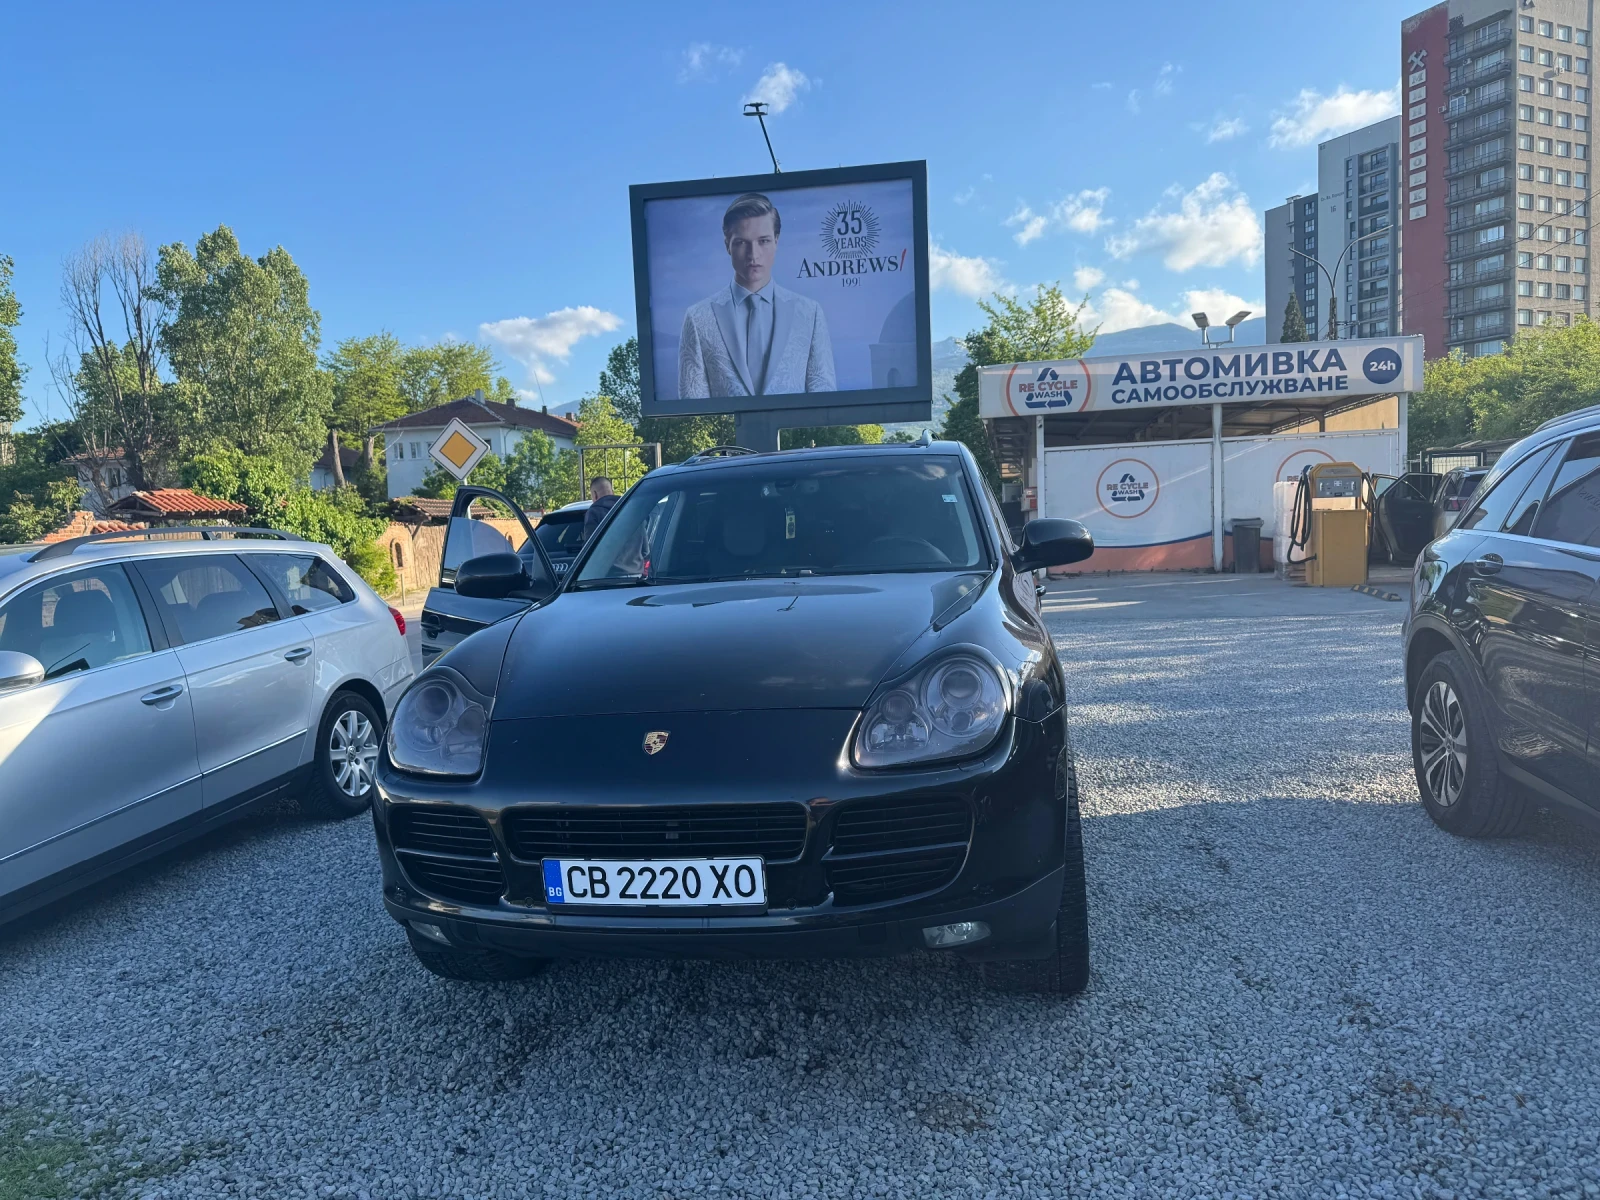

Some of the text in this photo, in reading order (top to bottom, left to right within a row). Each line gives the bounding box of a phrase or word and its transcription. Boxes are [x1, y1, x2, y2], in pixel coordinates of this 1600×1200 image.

[837, 209, 862, 235] 35
[834, 236, 867, 249] YEARS
[1112, 348, 1347, 386] АВТОМИВКА
[1369, 360, 1396, 372] 24h
[1018, 379, 1078, 393] RE CYCLE
[1111, 374, 1348, 404] САМООБСЛУЖВАНЕ
[1034, 390, 1063, 399] WASH
[1106, 482, 1149, 491] RE CYCLE
[548, 886, 562, 897] BG
[616, 865, 702, 899] 2220
